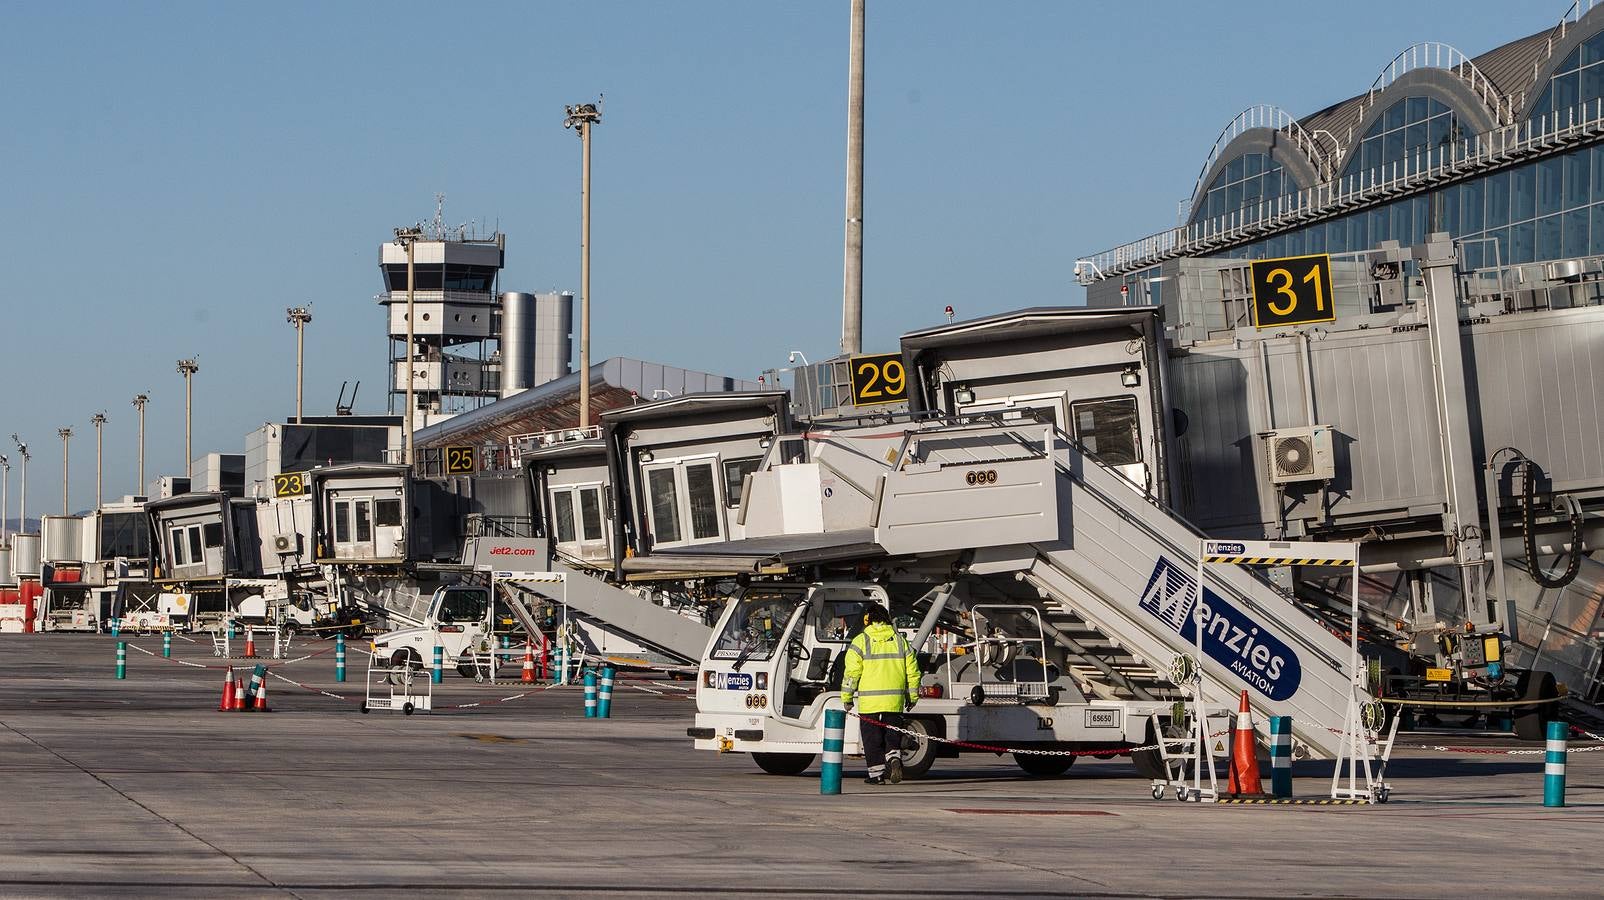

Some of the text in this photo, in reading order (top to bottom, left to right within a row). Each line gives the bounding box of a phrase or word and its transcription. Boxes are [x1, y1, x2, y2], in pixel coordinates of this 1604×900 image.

[1266, 264, 1324, 316] 31
[858, 360, 906, 398] 29
[450, 450, 472, 470] 25
[277, 475, 302, 495] 23
[967, 471, 996, 484] TCR
[490, 546, 535, 556] jet2.com
[1207, 543, 1242, 554] Menzies
[1141, 564, 1285, 681] Menzies
[718, 673, 750, 689] Menzies
[1230, 659, 1275, 695] AVIATION
[747, 695, 767, 707] TCR
